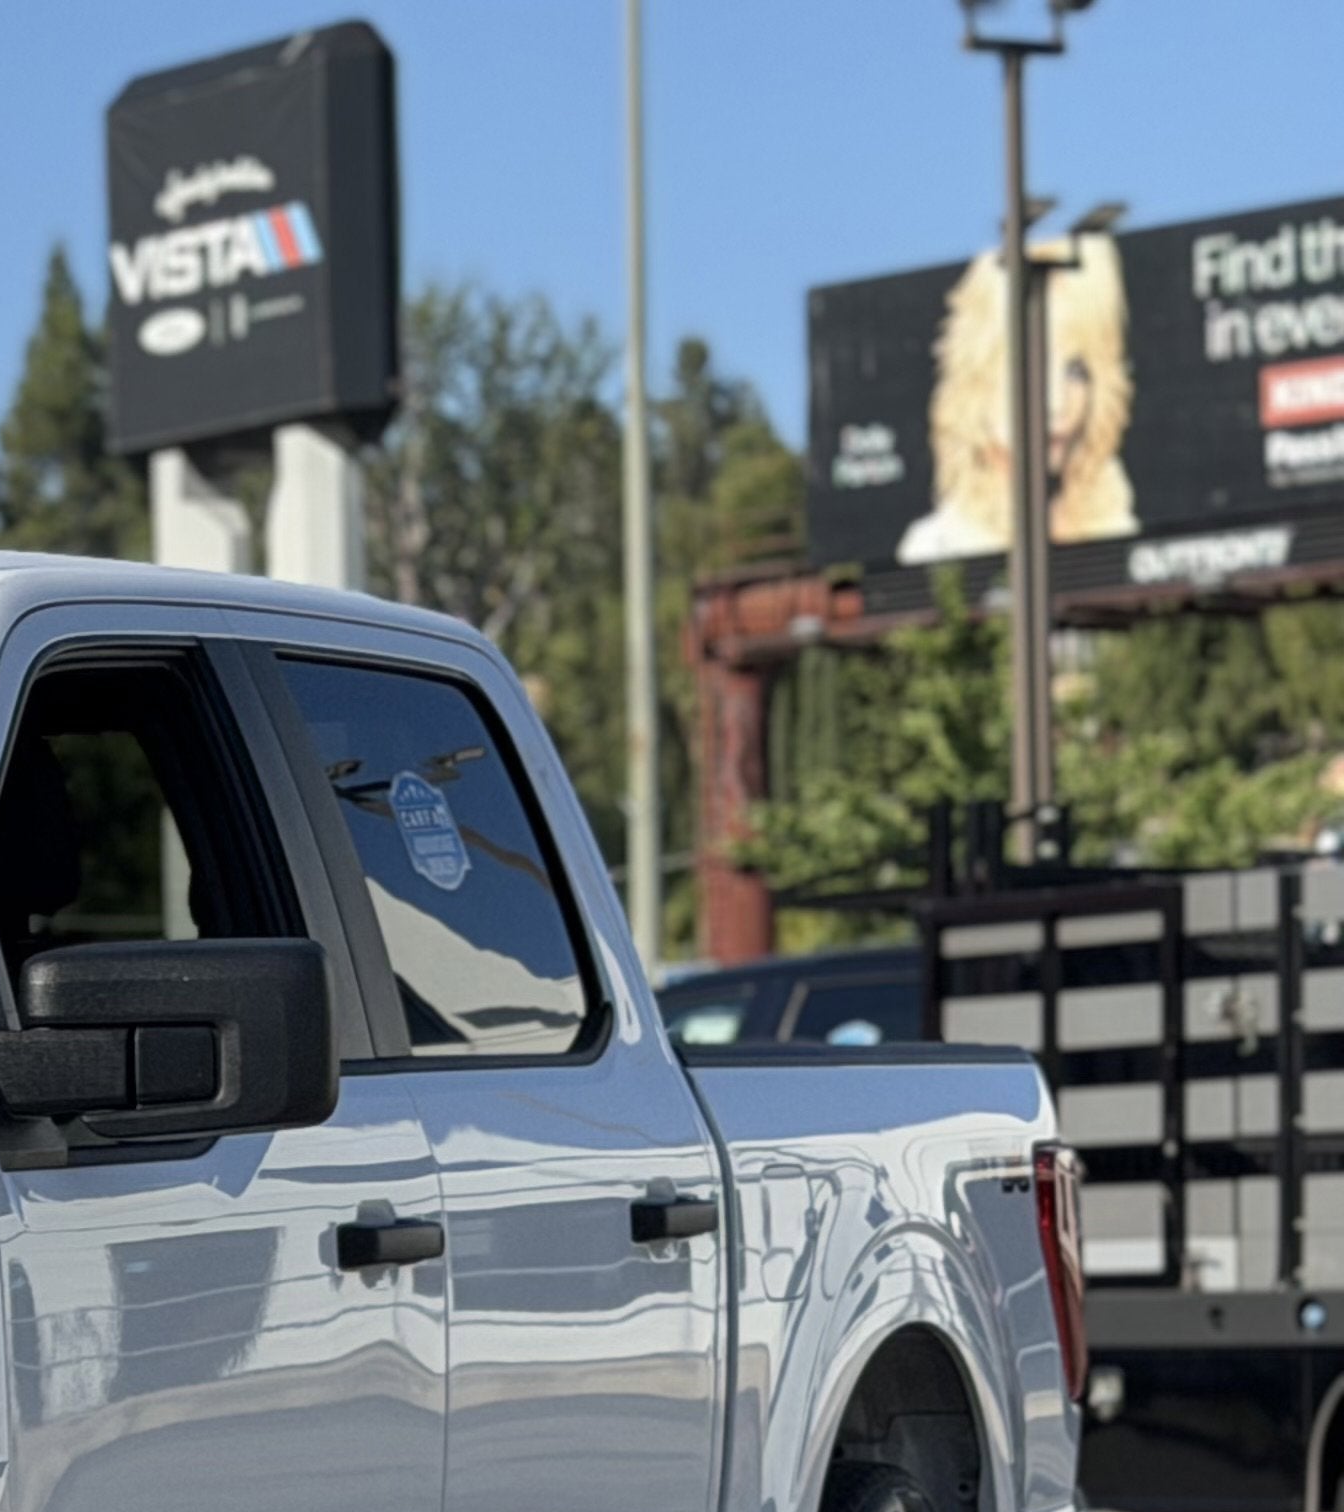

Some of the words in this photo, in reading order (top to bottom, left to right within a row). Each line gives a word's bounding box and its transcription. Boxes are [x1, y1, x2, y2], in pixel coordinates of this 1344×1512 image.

[110, 214, 269, 304] VISTA
[1192, 222, 1297, 299] Find
[1204, 299, 1251, 361] in
